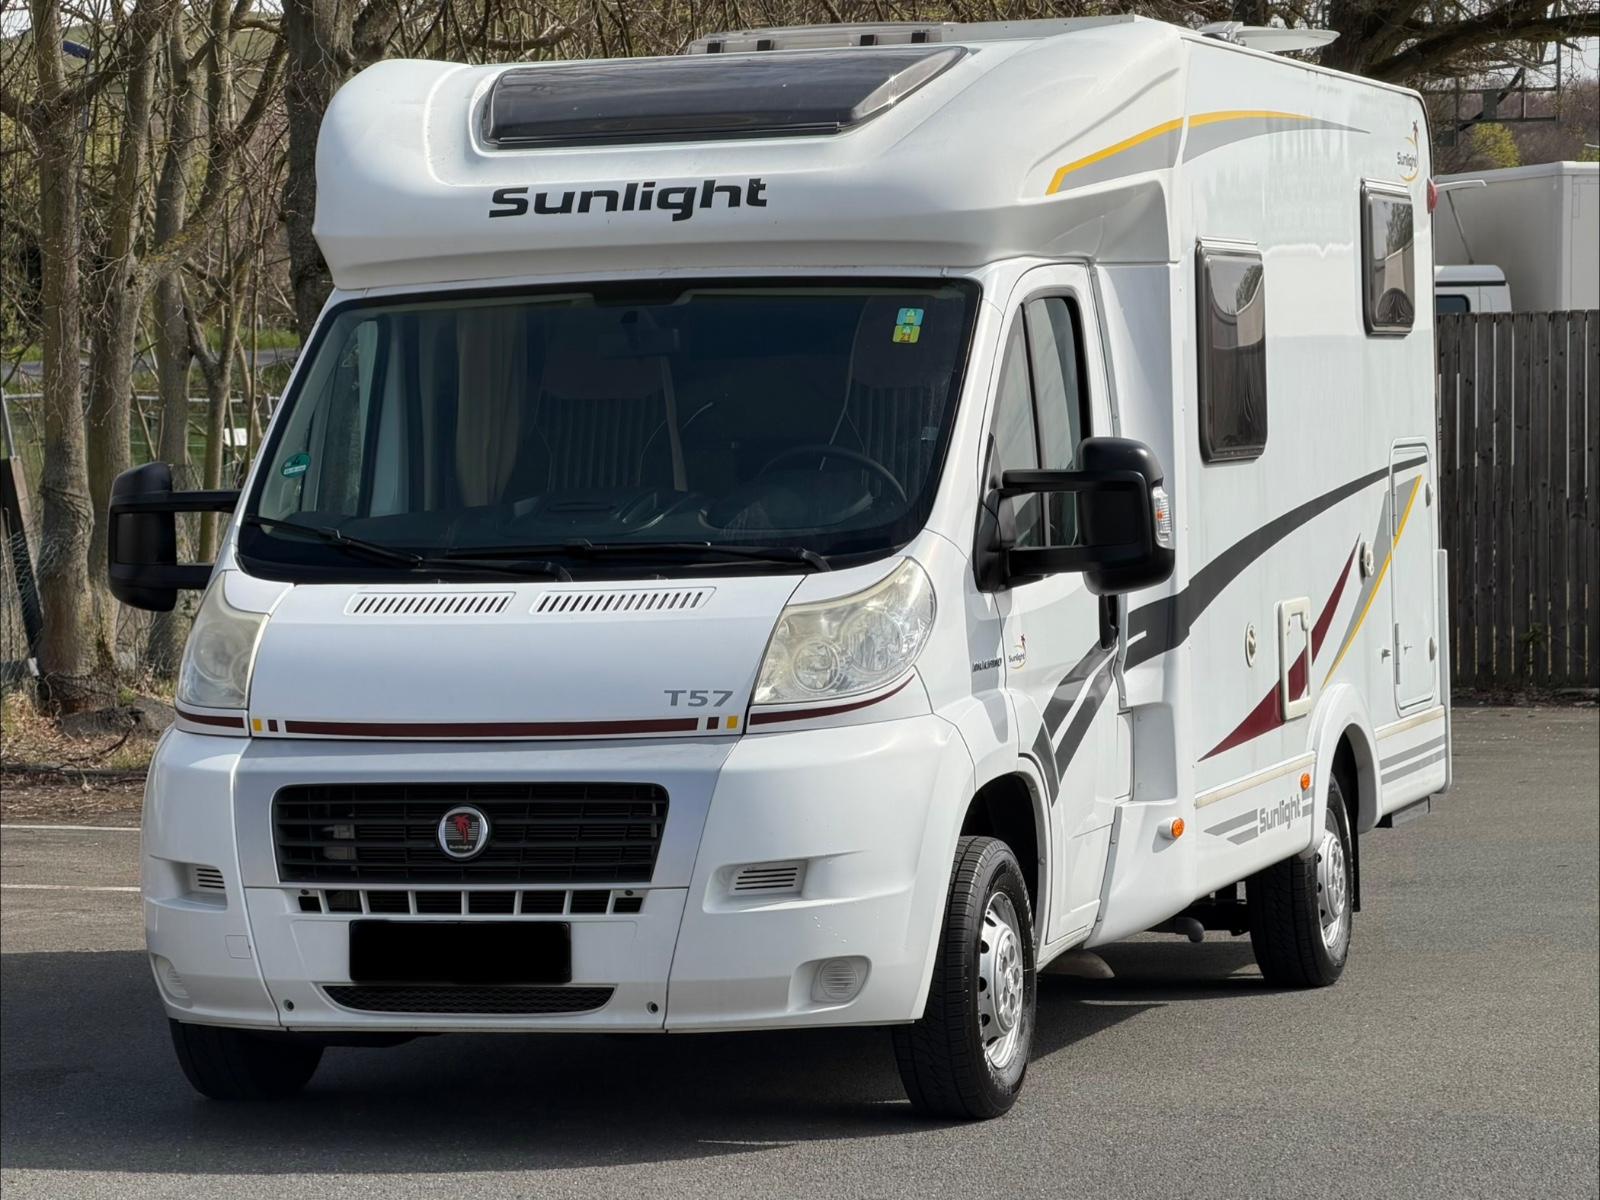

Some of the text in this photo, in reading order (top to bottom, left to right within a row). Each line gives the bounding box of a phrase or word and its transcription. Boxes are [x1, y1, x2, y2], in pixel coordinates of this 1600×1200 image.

[489, 178, 768, 221] Sunlight
[664, 690, 733, 707] T57
[1260, 794, 1301, 834] Sunlight
